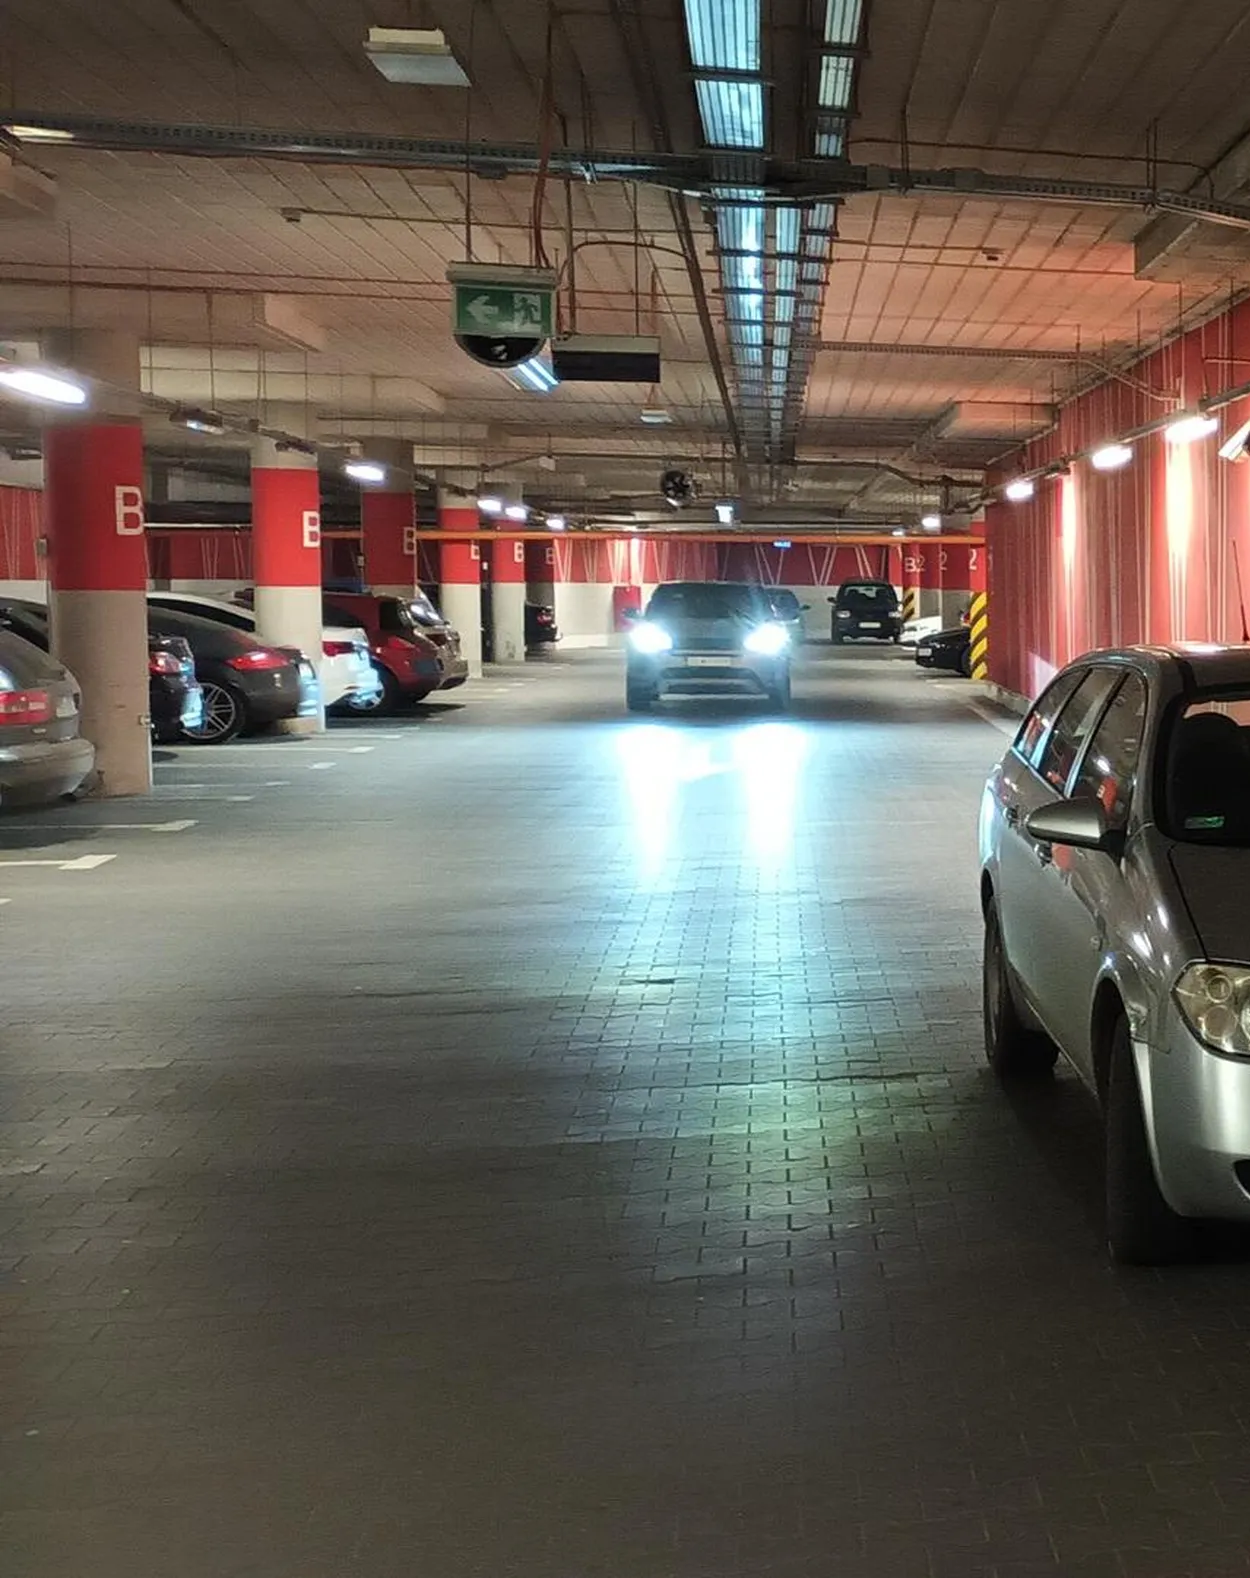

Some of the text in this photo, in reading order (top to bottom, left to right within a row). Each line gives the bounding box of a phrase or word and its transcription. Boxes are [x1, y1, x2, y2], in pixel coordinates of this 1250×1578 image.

[115, 485, 144, 535] B
[303, 511, 320, 547] B
[403, 526, 416, 554] B
[514, 542, 524, 563] B
[968, 548, 977, 570] 2
